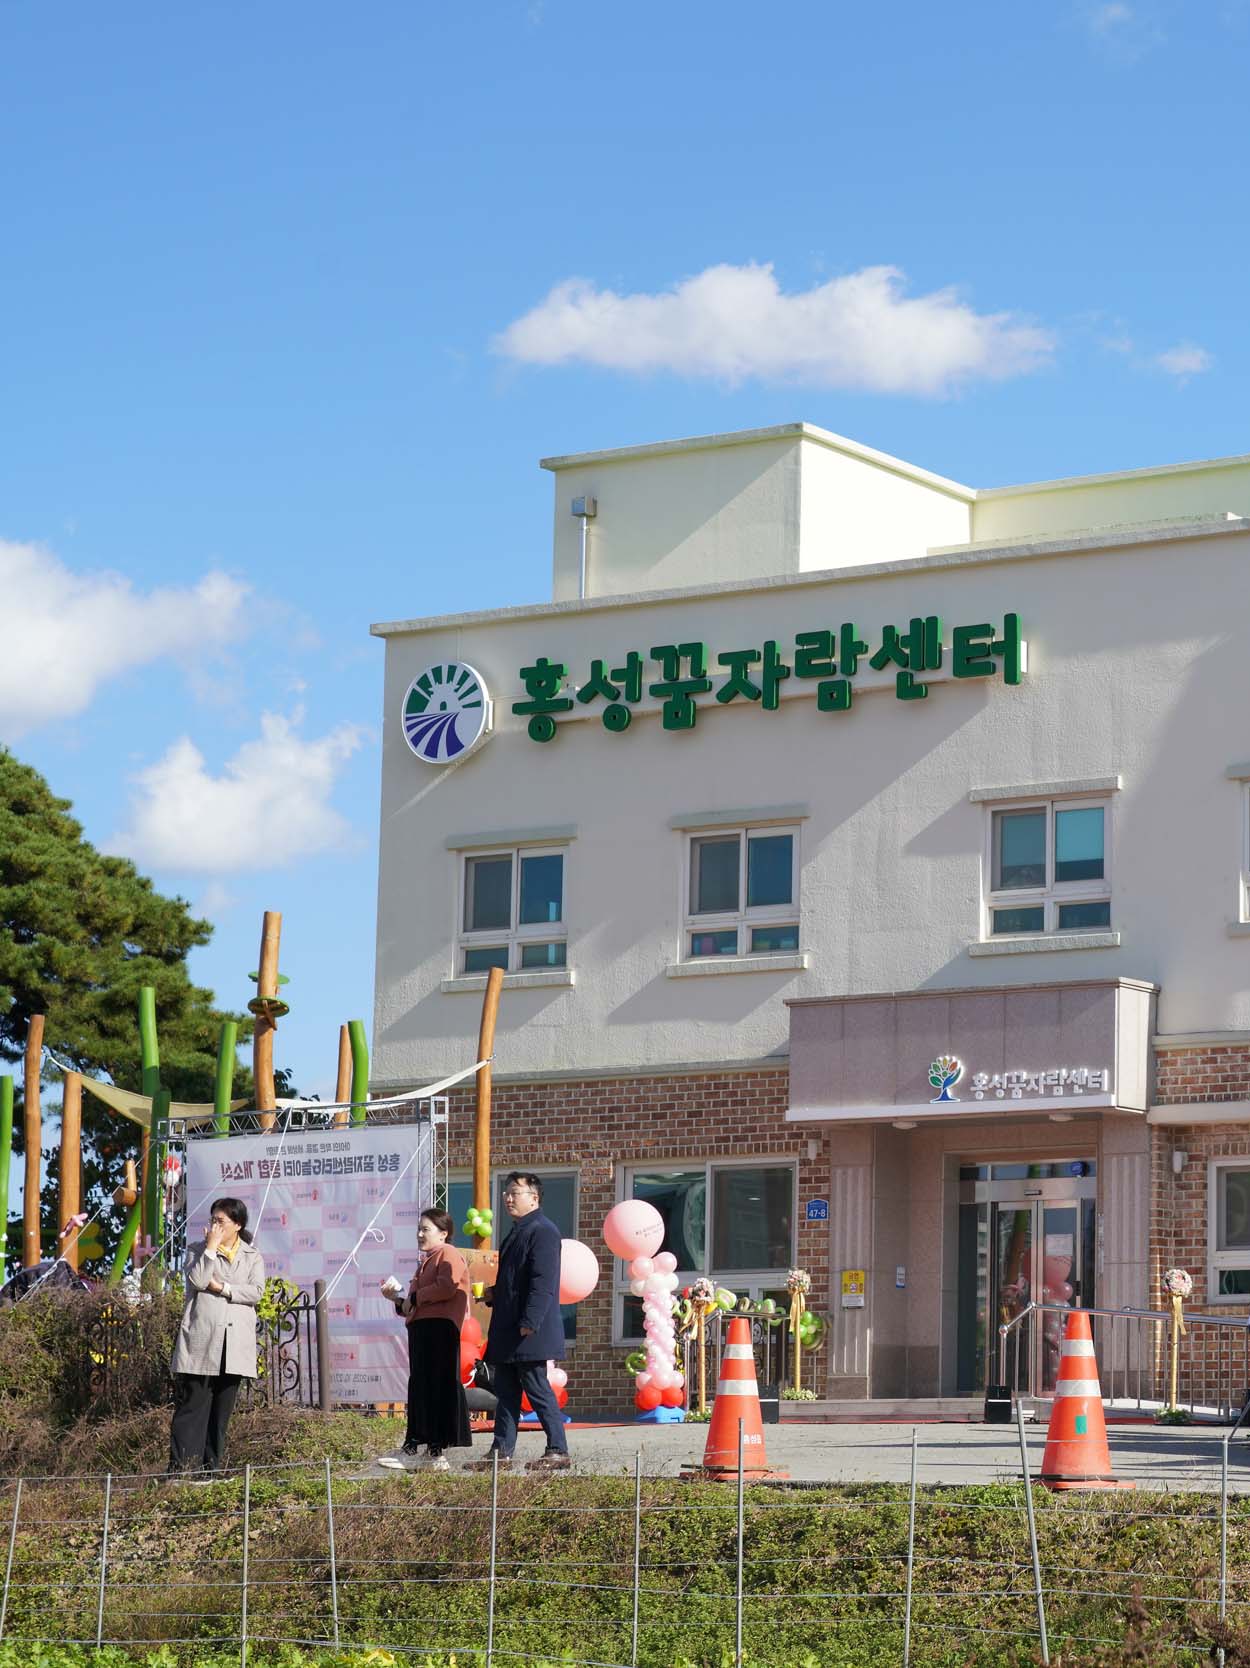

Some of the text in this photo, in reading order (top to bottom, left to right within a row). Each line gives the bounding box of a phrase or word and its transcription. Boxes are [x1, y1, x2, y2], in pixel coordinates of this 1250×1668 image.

[512, 613, 1021, 743] 홍성꿈자람센터
[970, 1068, 1108, 1100] 홍성꿈자람센터
[808, 1209, 826, 1218] 47-8
